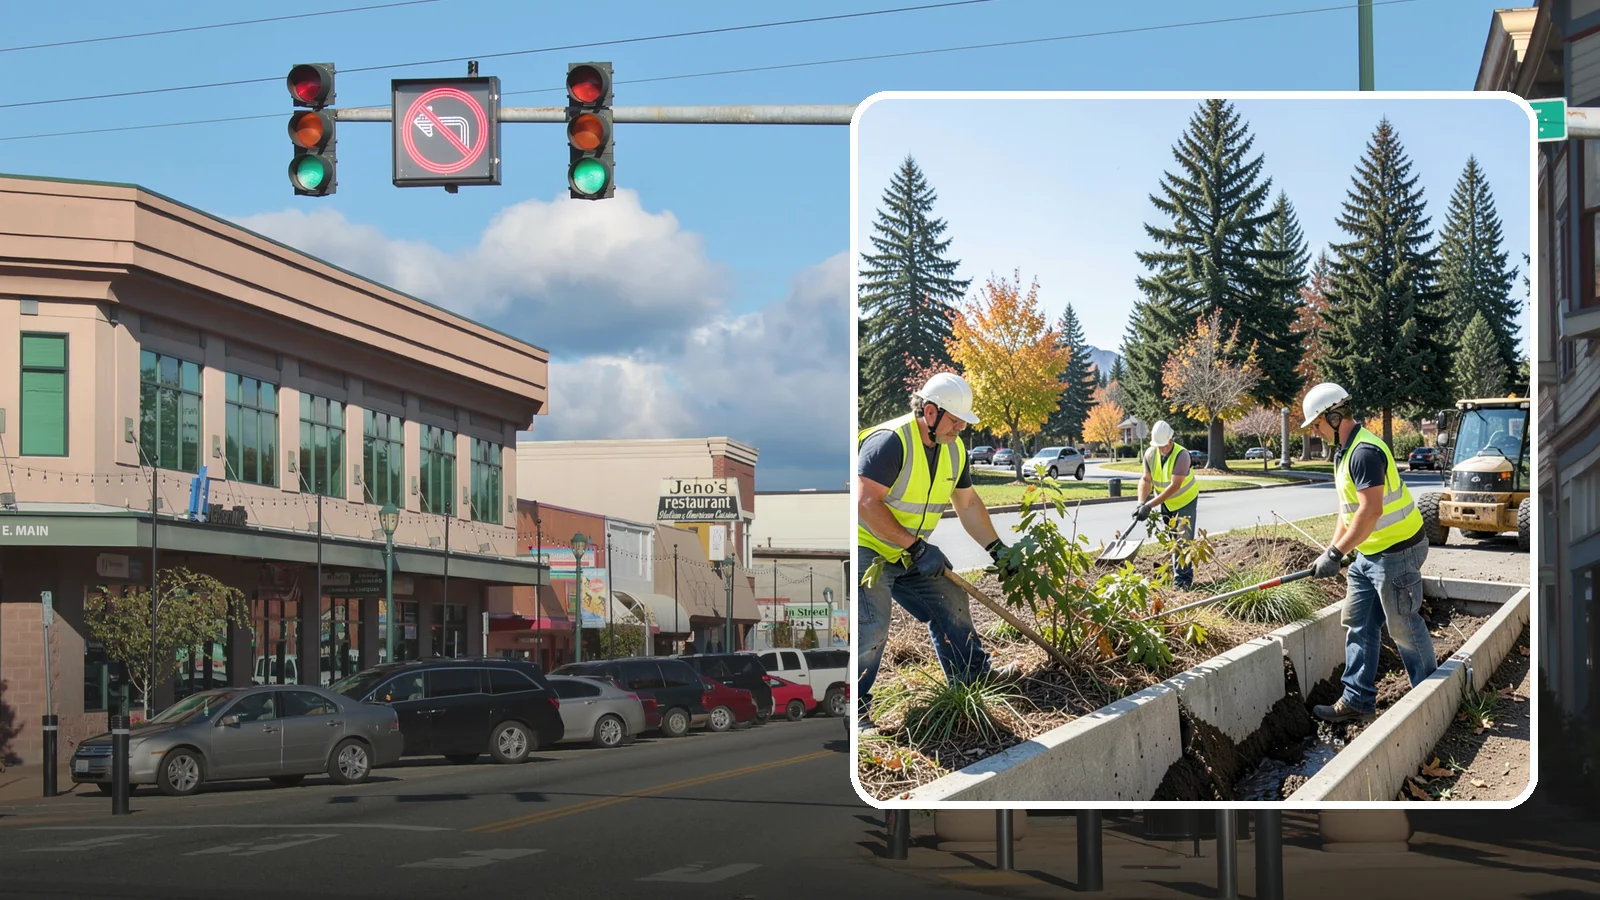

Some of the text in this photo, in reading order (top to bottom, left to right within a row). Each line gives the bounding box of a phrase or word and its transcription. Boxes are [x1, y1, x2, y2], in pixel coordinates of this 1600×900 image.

[670, 480, 727, 494] Jeno's
[665, 497, 731, 508] restaurant
[659, 510, 682, 519] Italian
[686, 510, 714, 518] American
[715, 510, 737, 518] Cuisine
[2, 526, 48, 536] E. MAIN
[798, 608, 828, 616] Street
